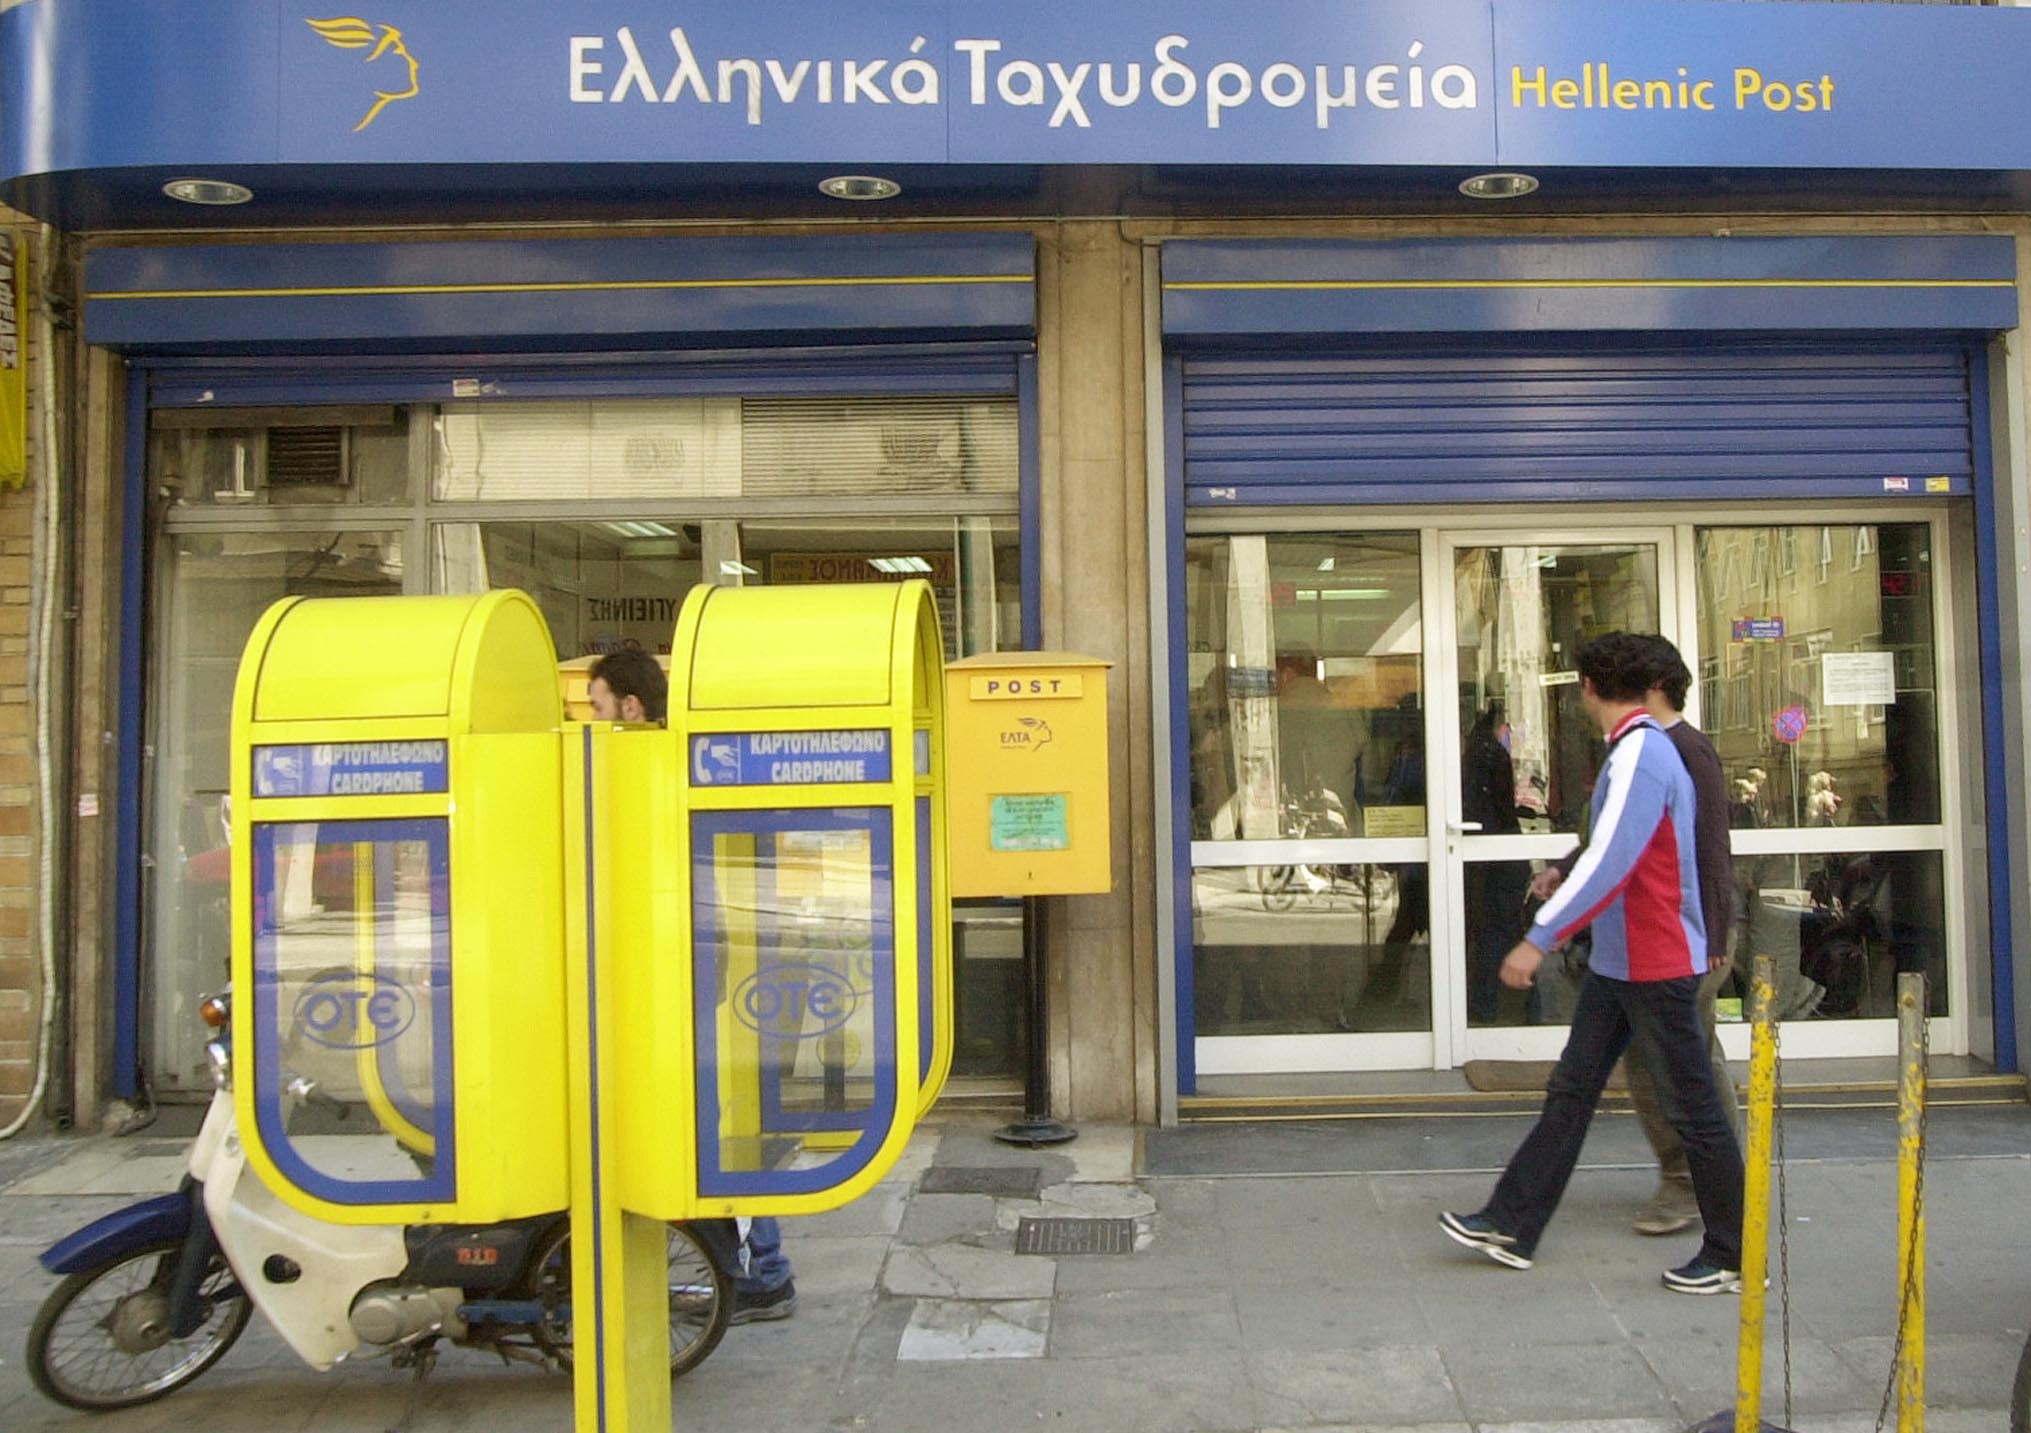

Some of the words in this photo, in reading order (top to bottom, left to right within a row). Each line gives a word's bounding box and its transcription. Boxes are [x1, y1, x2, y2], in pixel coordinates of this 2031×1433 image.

[568, 26, 940, 126] Ελληνικά
[954, 33, 1478, 128] Ταχυδρομεία
[1511, 60, 1715, 111] Hellenic
[1733, 67, 1835, 112] Post
[987, 679, 1062, 695] POST
[751, 730, 885, 755] ΚΑΡΤΟΤΗΛΕΦΩΝΟ
[331, 771, 425, 793] CARDPHONE
[771, 759, 865, 783] CARDPHONE
